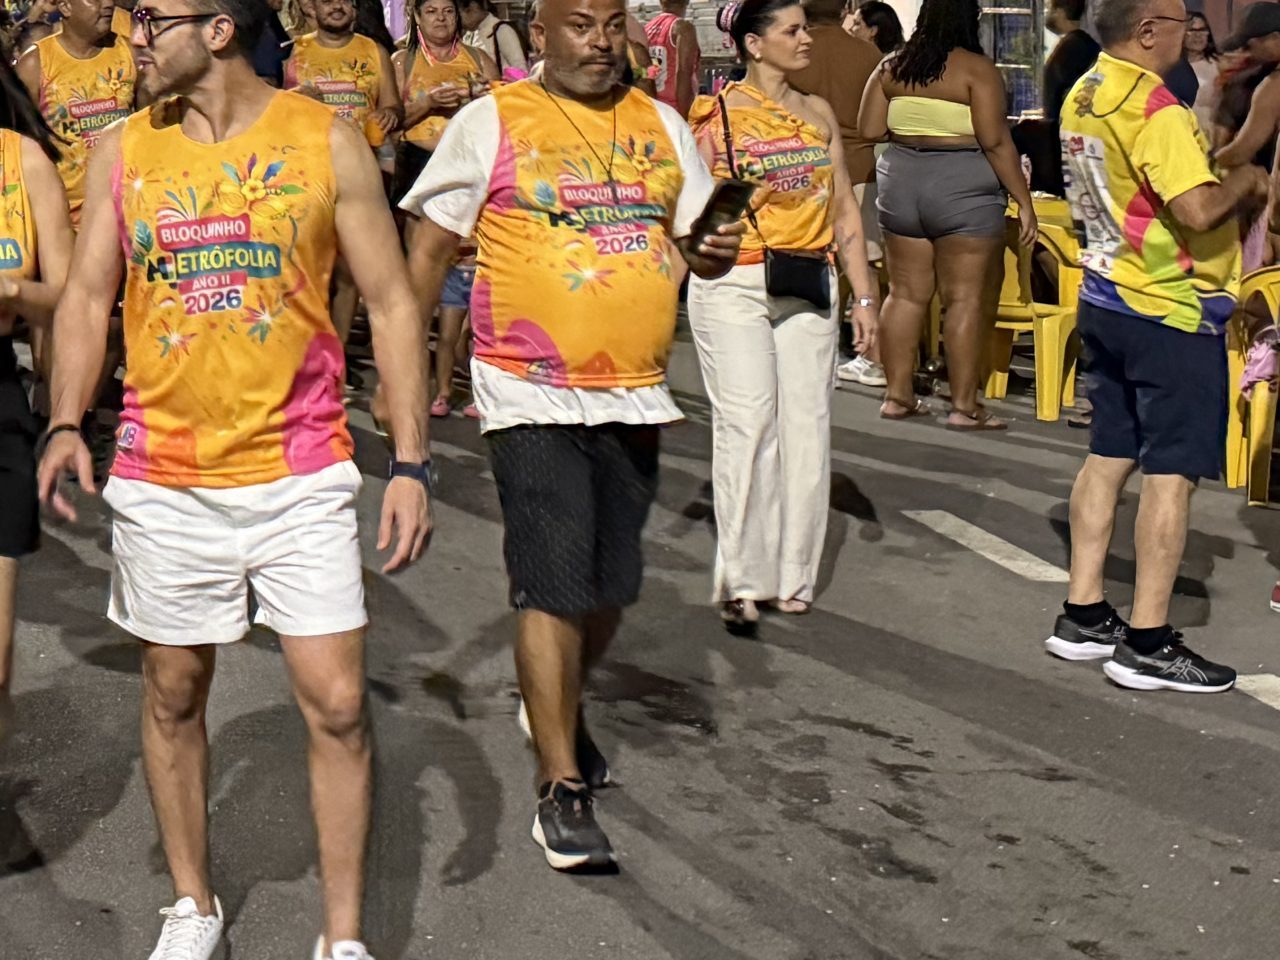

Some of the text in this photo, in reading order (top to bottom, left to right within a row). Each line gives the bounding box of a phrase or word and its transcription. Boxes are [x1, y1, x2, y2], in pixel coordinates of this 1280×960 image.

[70, 99, 116, 116] BLOQUINHO
[771, 175, 811, 193] 2026
[161, 219, 247, 244] BLOQUINHO
[595, 233, 649, 256] 2026
[192, 274, 231, 291] ANO II
[184, 287, 242, 316] 2026
